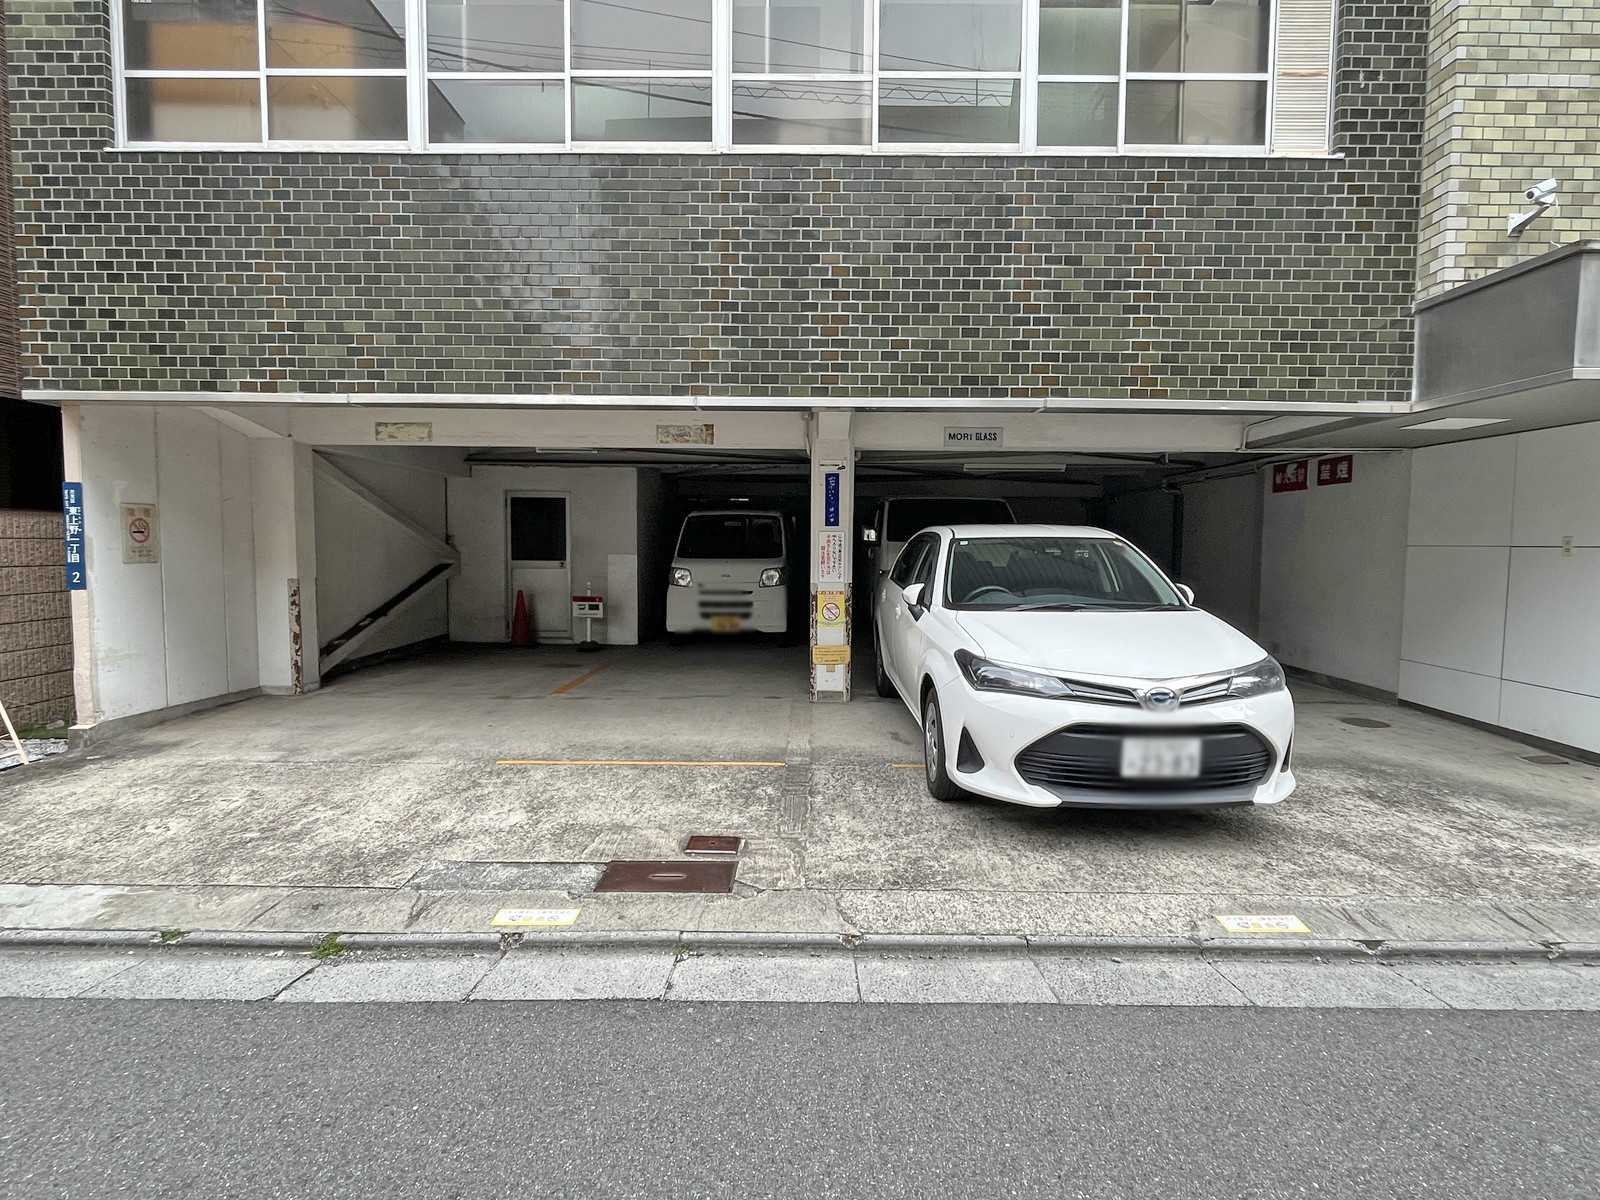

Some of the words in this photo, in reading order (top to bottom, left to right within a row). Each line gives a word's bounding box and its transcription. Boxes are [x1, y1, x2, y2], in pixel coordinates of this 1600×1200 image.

[948, 432, 972, 441] MORI
[975, 432, 998, 441] GLASS
[1319, 461, 1349, 480] 禁煙
[69, 506, 80, 563] 東上野一丁目
[72, 571, 81, 583] 2
